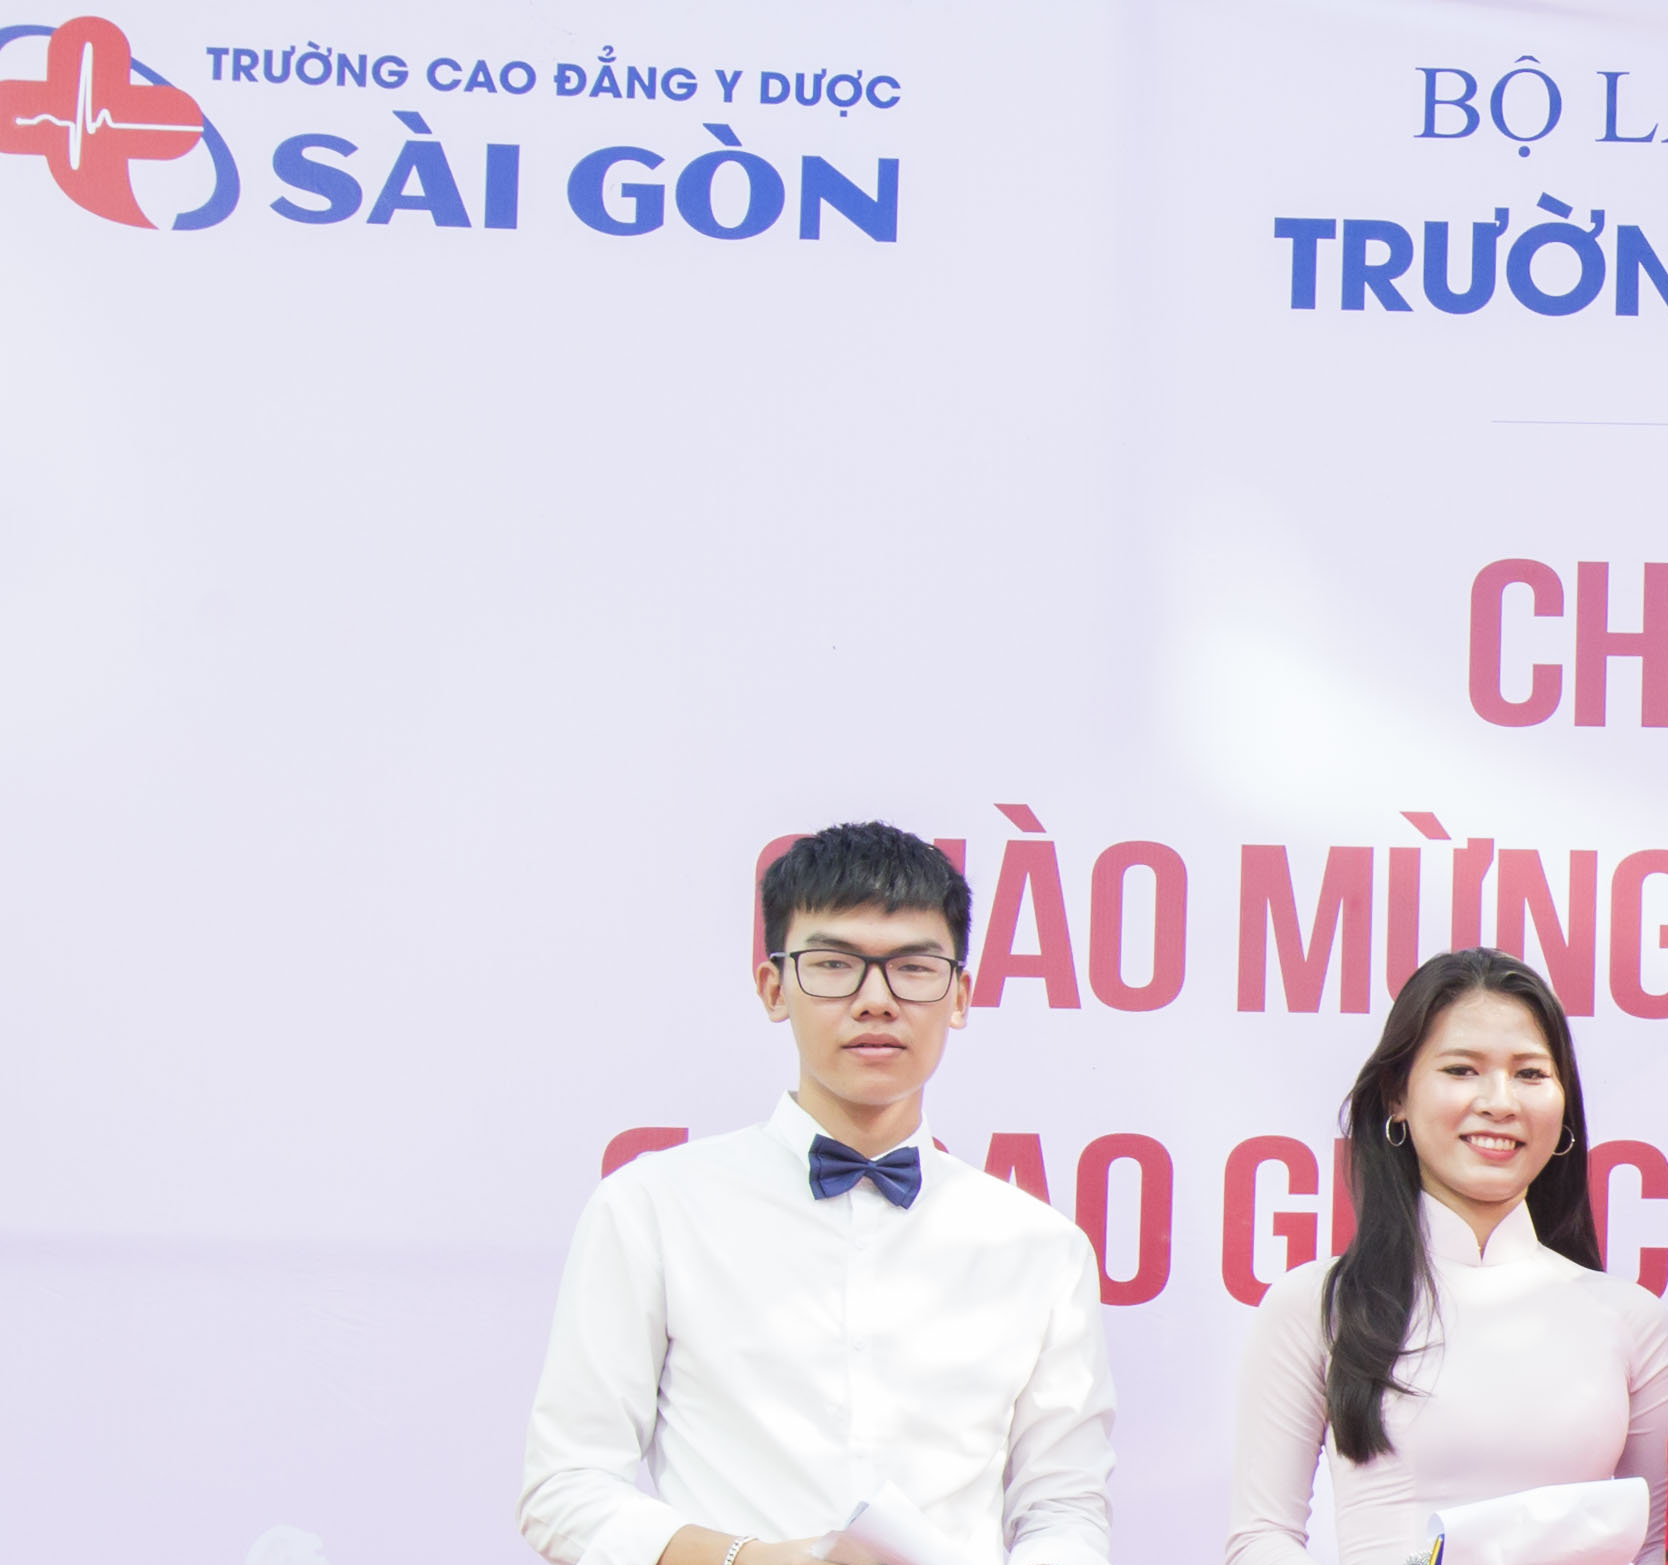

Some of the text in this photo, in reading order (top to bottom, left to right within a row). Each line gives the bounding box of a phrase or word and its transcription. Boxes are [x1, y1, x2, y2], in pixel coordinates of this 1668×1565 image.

[207, 41, 902, 119] TRƯỜNG CAO ĐẲNG Y DƯỢC
[1414, 55, 1563, 158] BỘ
[271, 110, 900, 243] SÀI GÒN
[753, 803, 1188, 1012] ÀO
